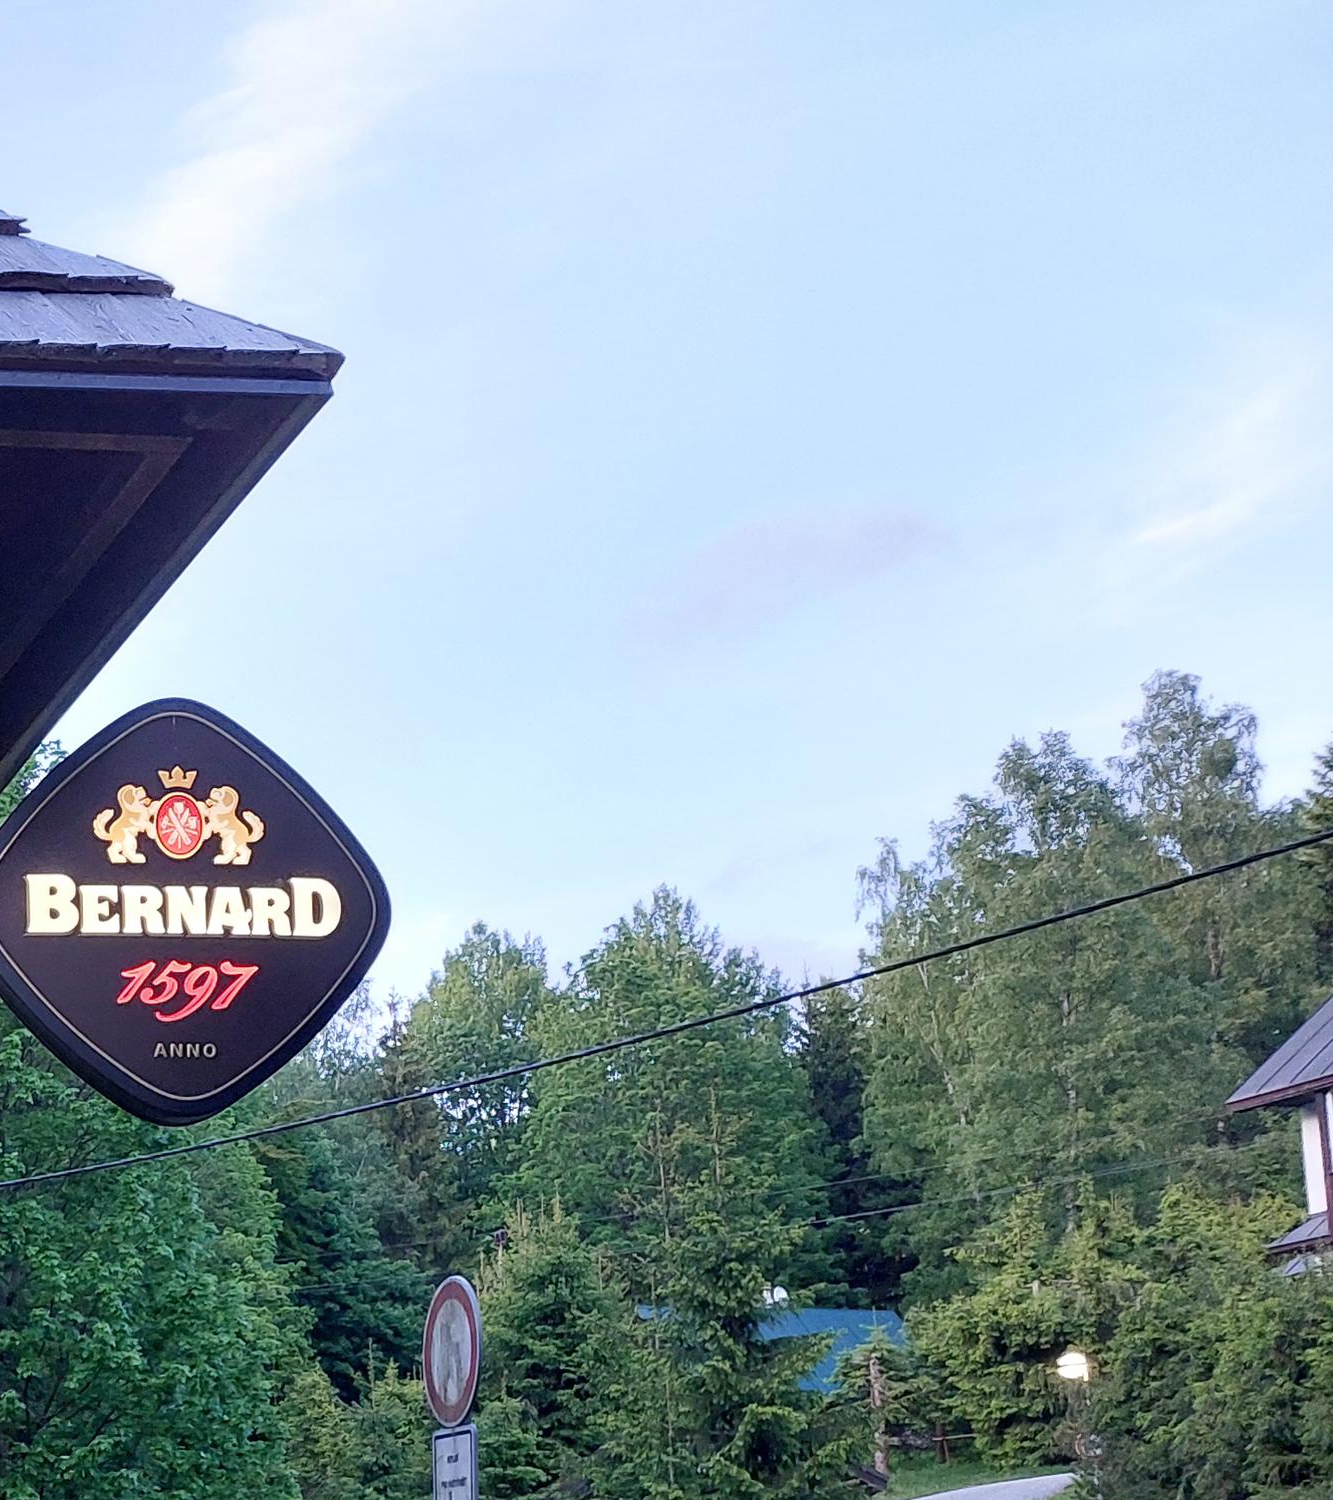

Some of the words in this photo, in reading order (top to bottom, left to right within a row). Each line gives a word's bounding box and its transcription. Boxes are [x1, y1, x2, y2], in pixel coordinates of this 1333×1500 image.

[24, 873, 341, 938] BERNARD
[116, 960, 260, 1022] 1597
[153, 1042, 217, 1058] ANNO
